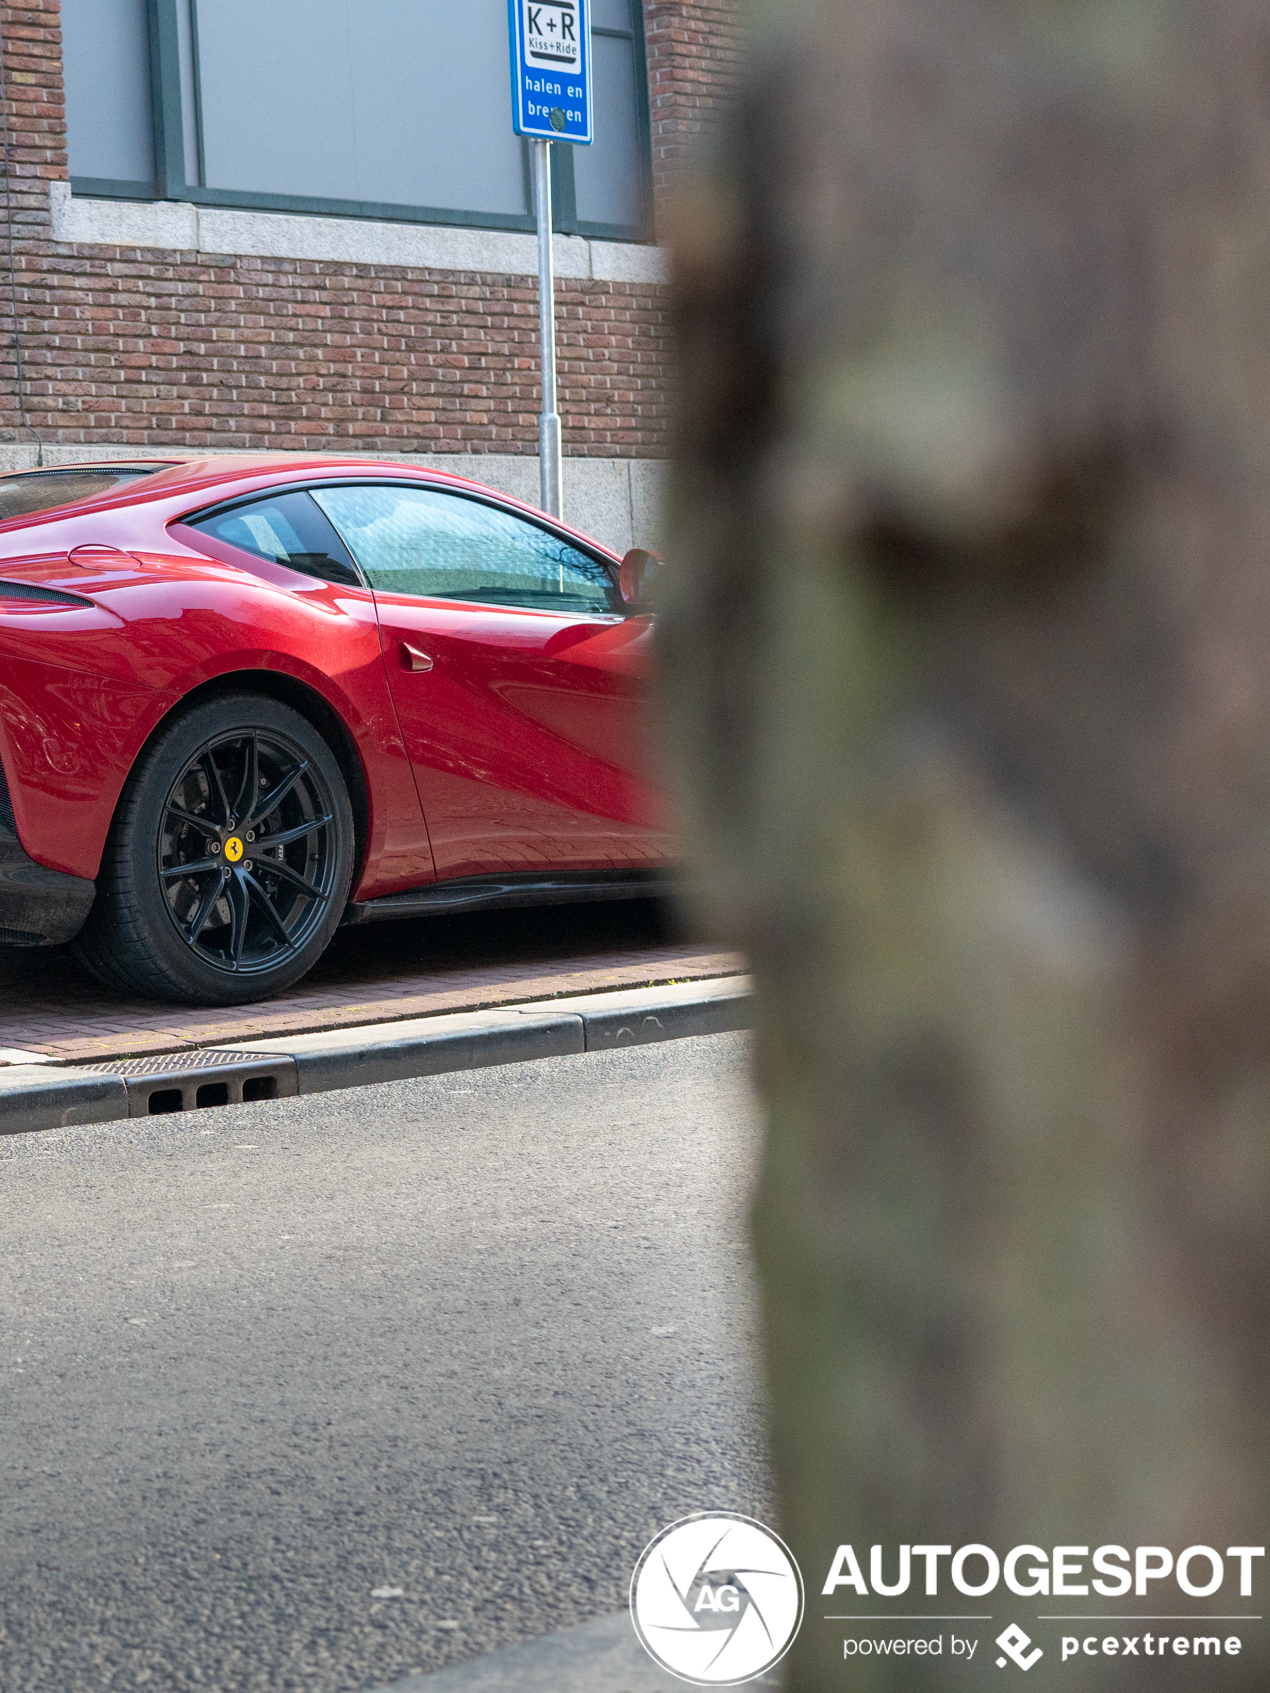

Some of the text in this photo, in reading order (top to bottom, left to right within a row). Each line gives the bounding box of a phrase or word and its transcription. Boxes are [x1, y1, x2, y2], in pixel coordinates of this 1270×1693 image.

[529, 37, 577, 56] Kiss+Ride
[525, 75, 583, 99] halen en
[528, 100, 582, 123] breen
